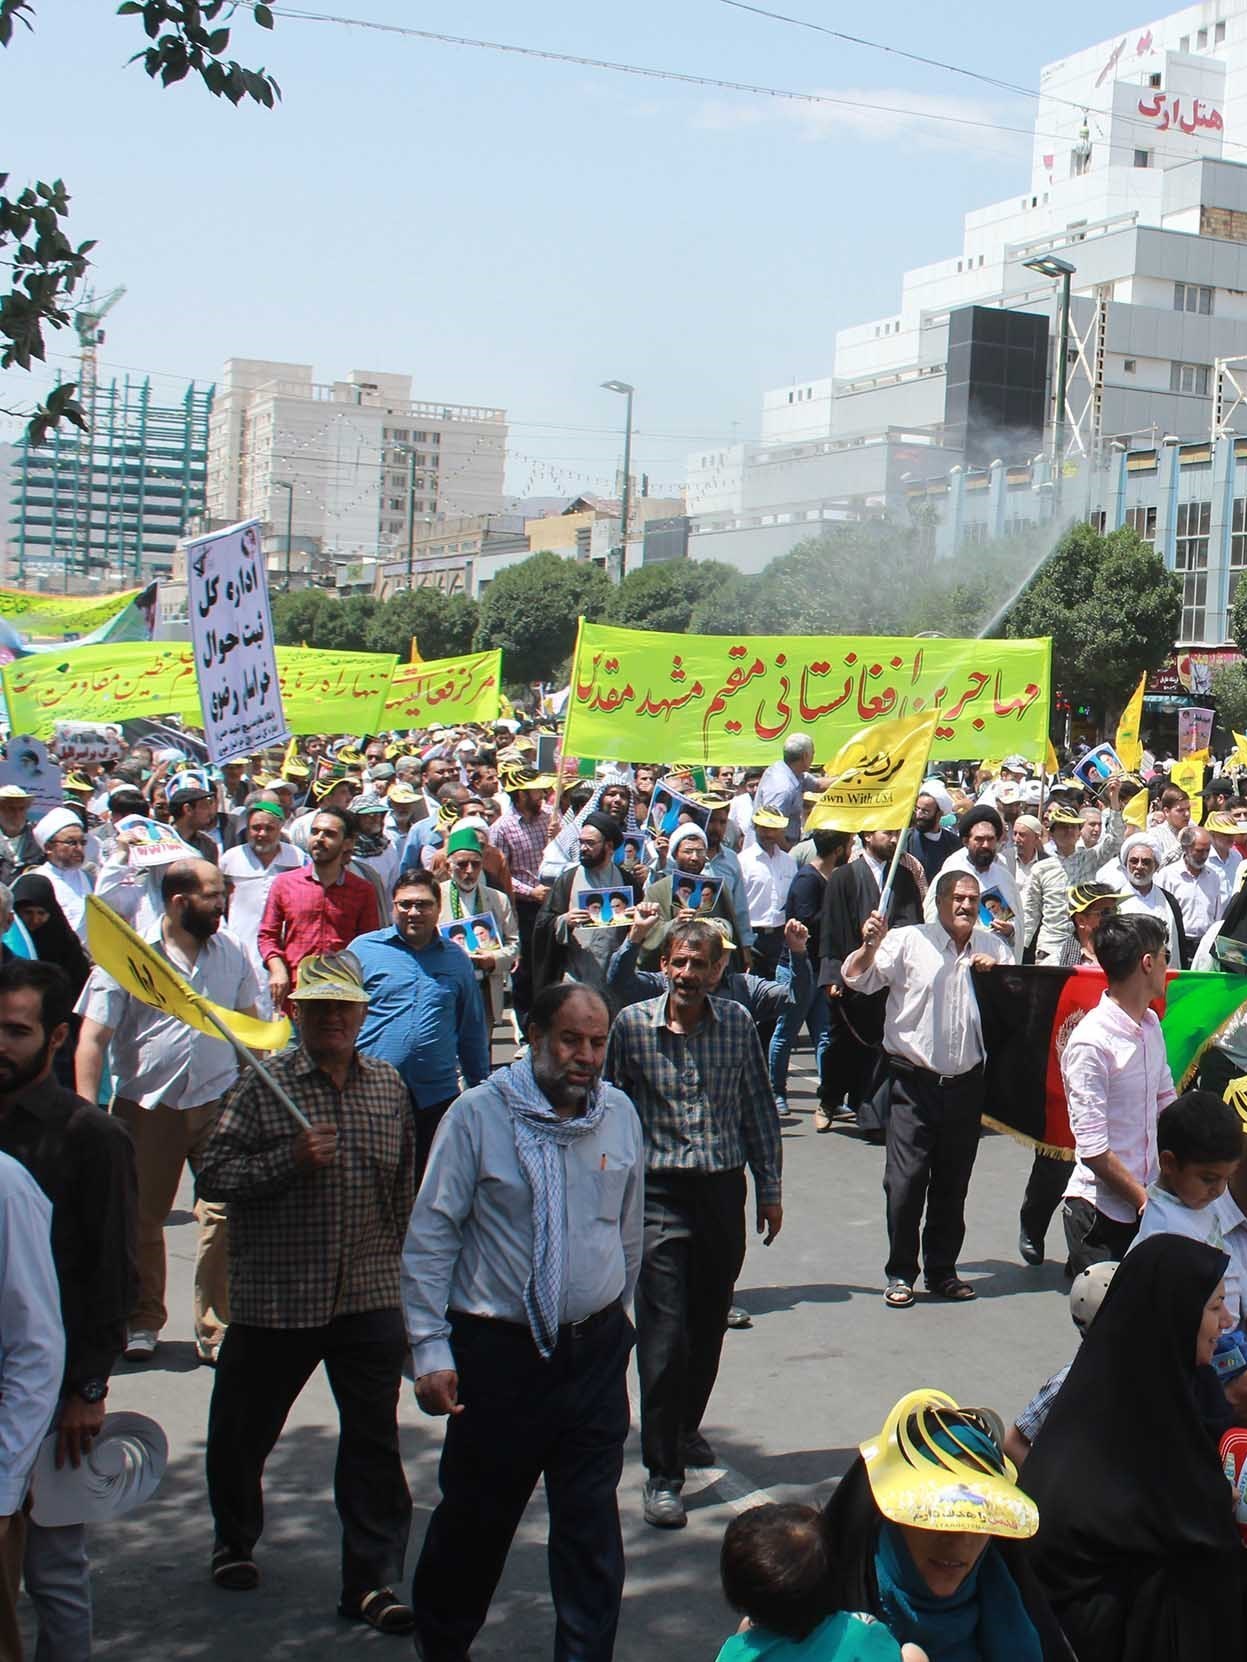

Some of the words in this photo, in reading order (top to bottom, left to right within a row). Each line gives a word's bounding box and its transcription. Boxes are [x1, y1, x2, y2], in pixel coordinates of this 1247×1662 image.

[1179, 98, 1224, 135] هتل
[199, 573, 220, 618] کل
[225, 562, 259, 609] اداره
[635, 655, 706, 723] مشهد
[702, 646, 768, 762] مقیم
[754, 648, 924, 745] افغانستانی
[847, 792, 873, 805] With
[875, 792, 894, 804] USA
